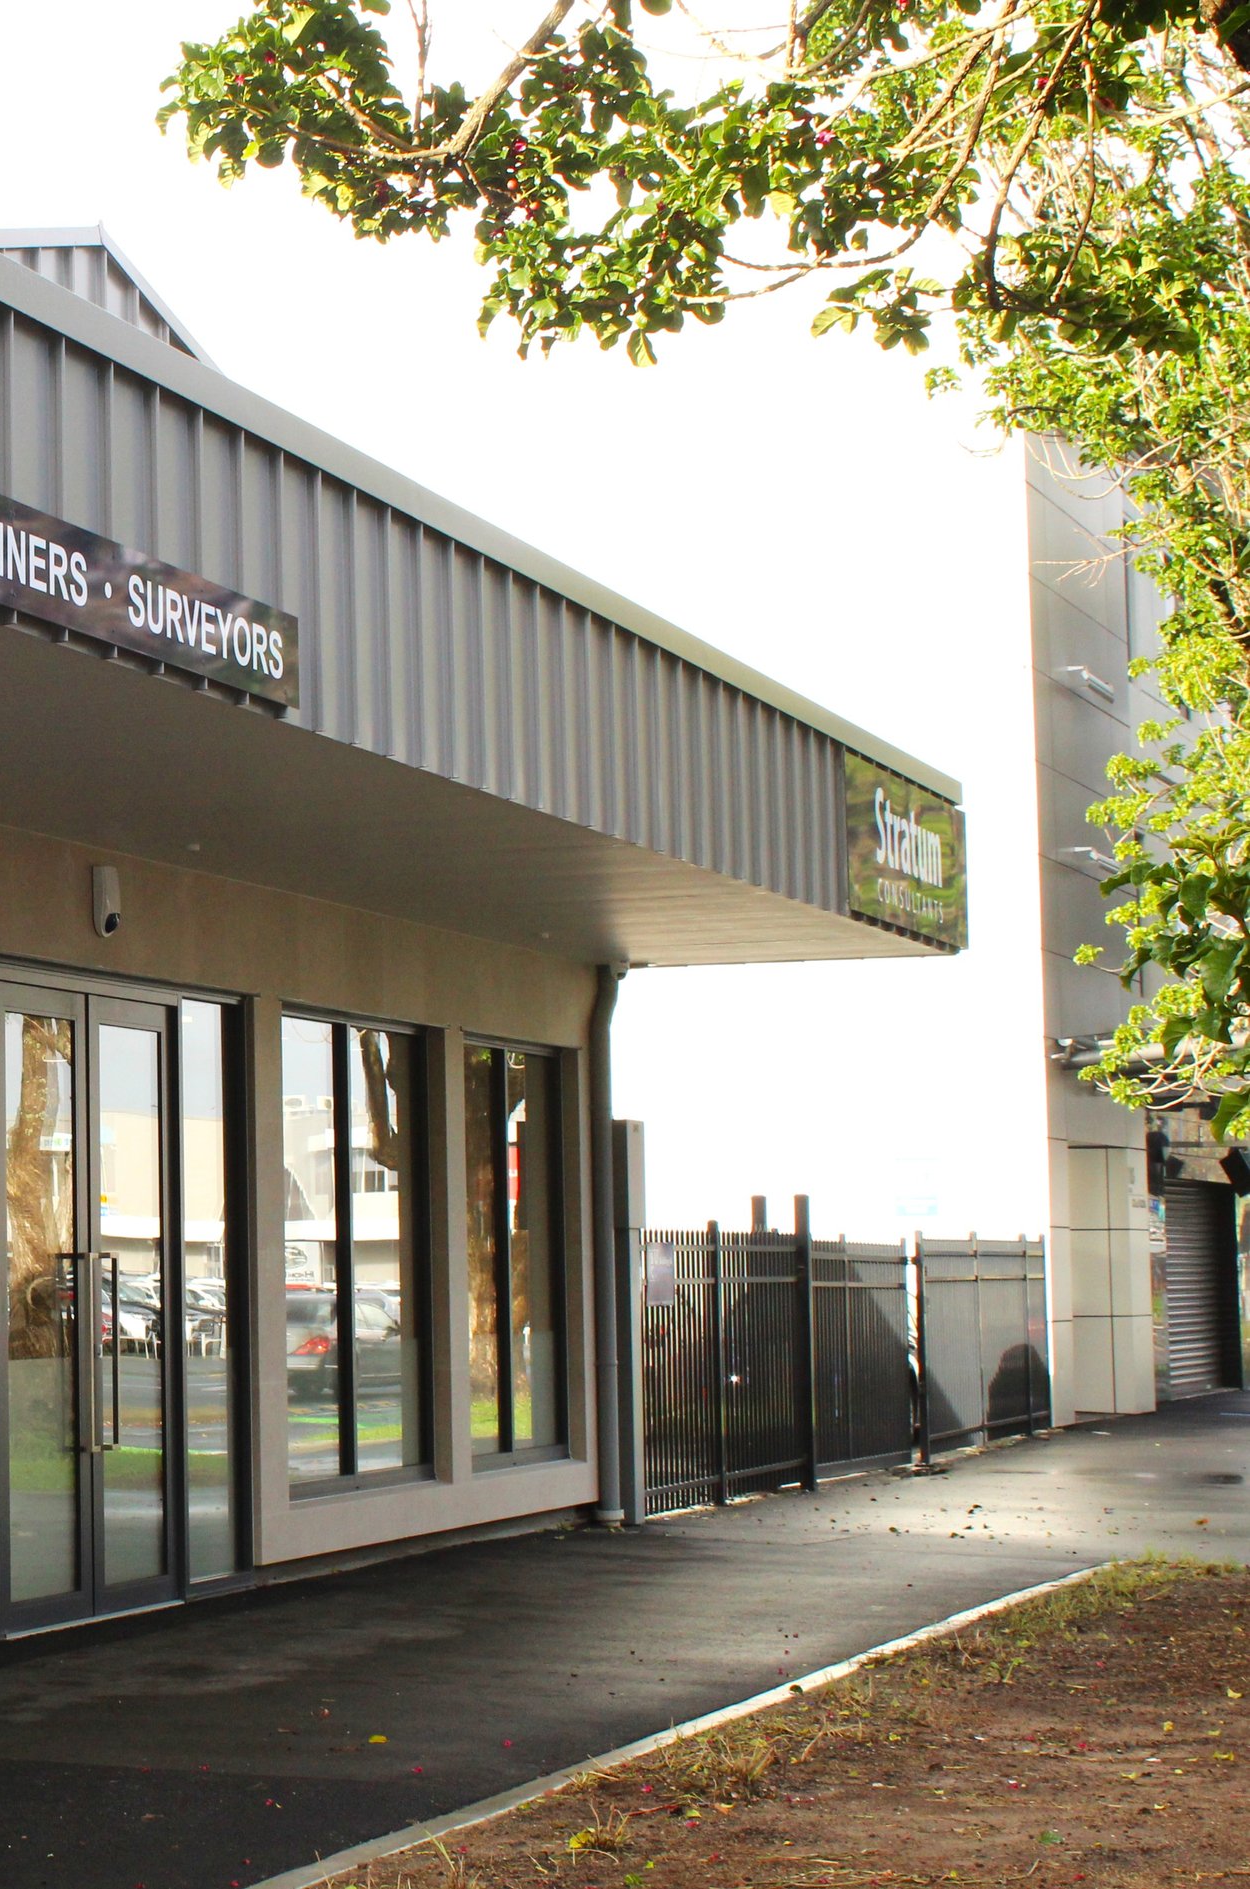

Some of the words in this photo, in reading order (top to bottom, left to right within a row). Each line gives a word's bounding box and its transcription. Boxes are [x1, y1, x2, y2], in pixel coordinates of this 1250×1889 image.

[128, 574, 284, 680] SURVEYORS
[874, 787, 942, 888] Stratum
[877, 878, 943, 923] CONSULTANTS
